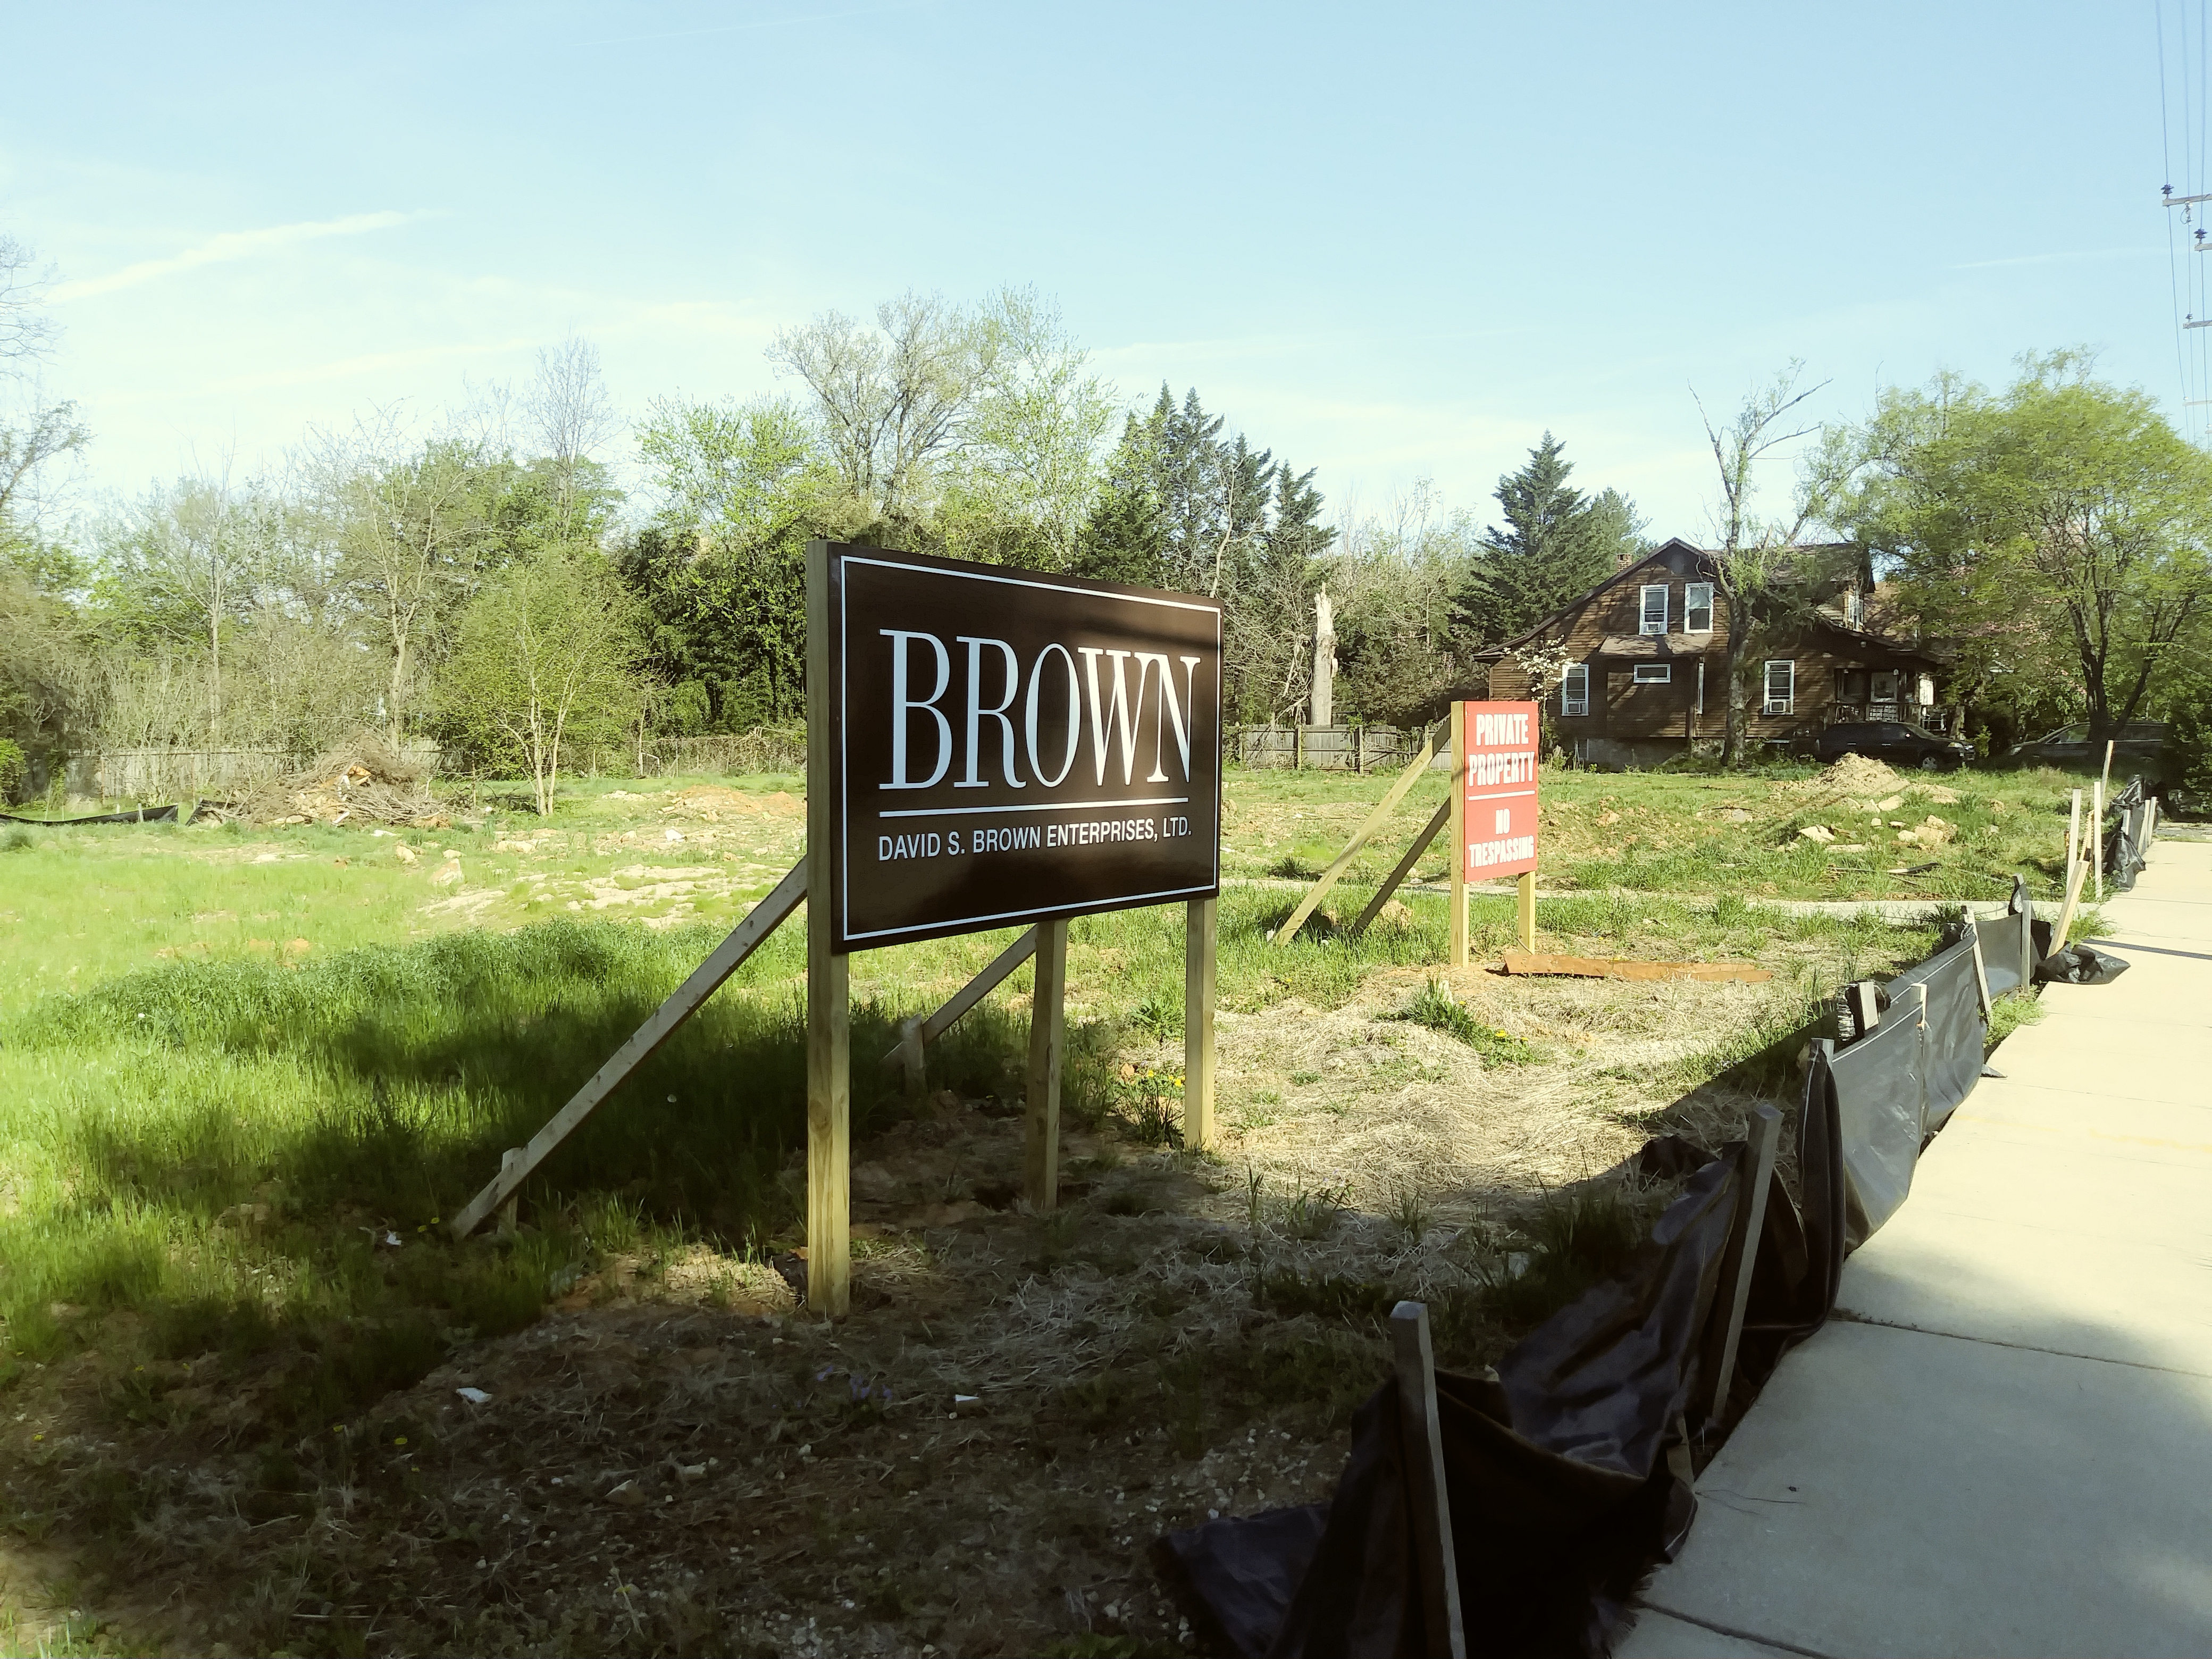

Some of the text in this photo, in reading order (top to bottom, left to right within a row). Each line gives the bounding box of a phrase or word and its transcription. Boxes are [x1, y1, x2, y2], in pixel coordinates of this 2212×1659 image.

[879, 629, 1201, 790] BROWN
[1476, 714, 1529, 746] PRIVATE
[1468, 751, 1535, 786] PROPERTY
[879, 816, 1192, 861] DAVID S. BROWN ENTERPRISES, LTD.
[1495, 808, 1510, 835] NO
[1469, 835, 1534, 868] TRESPASSING
